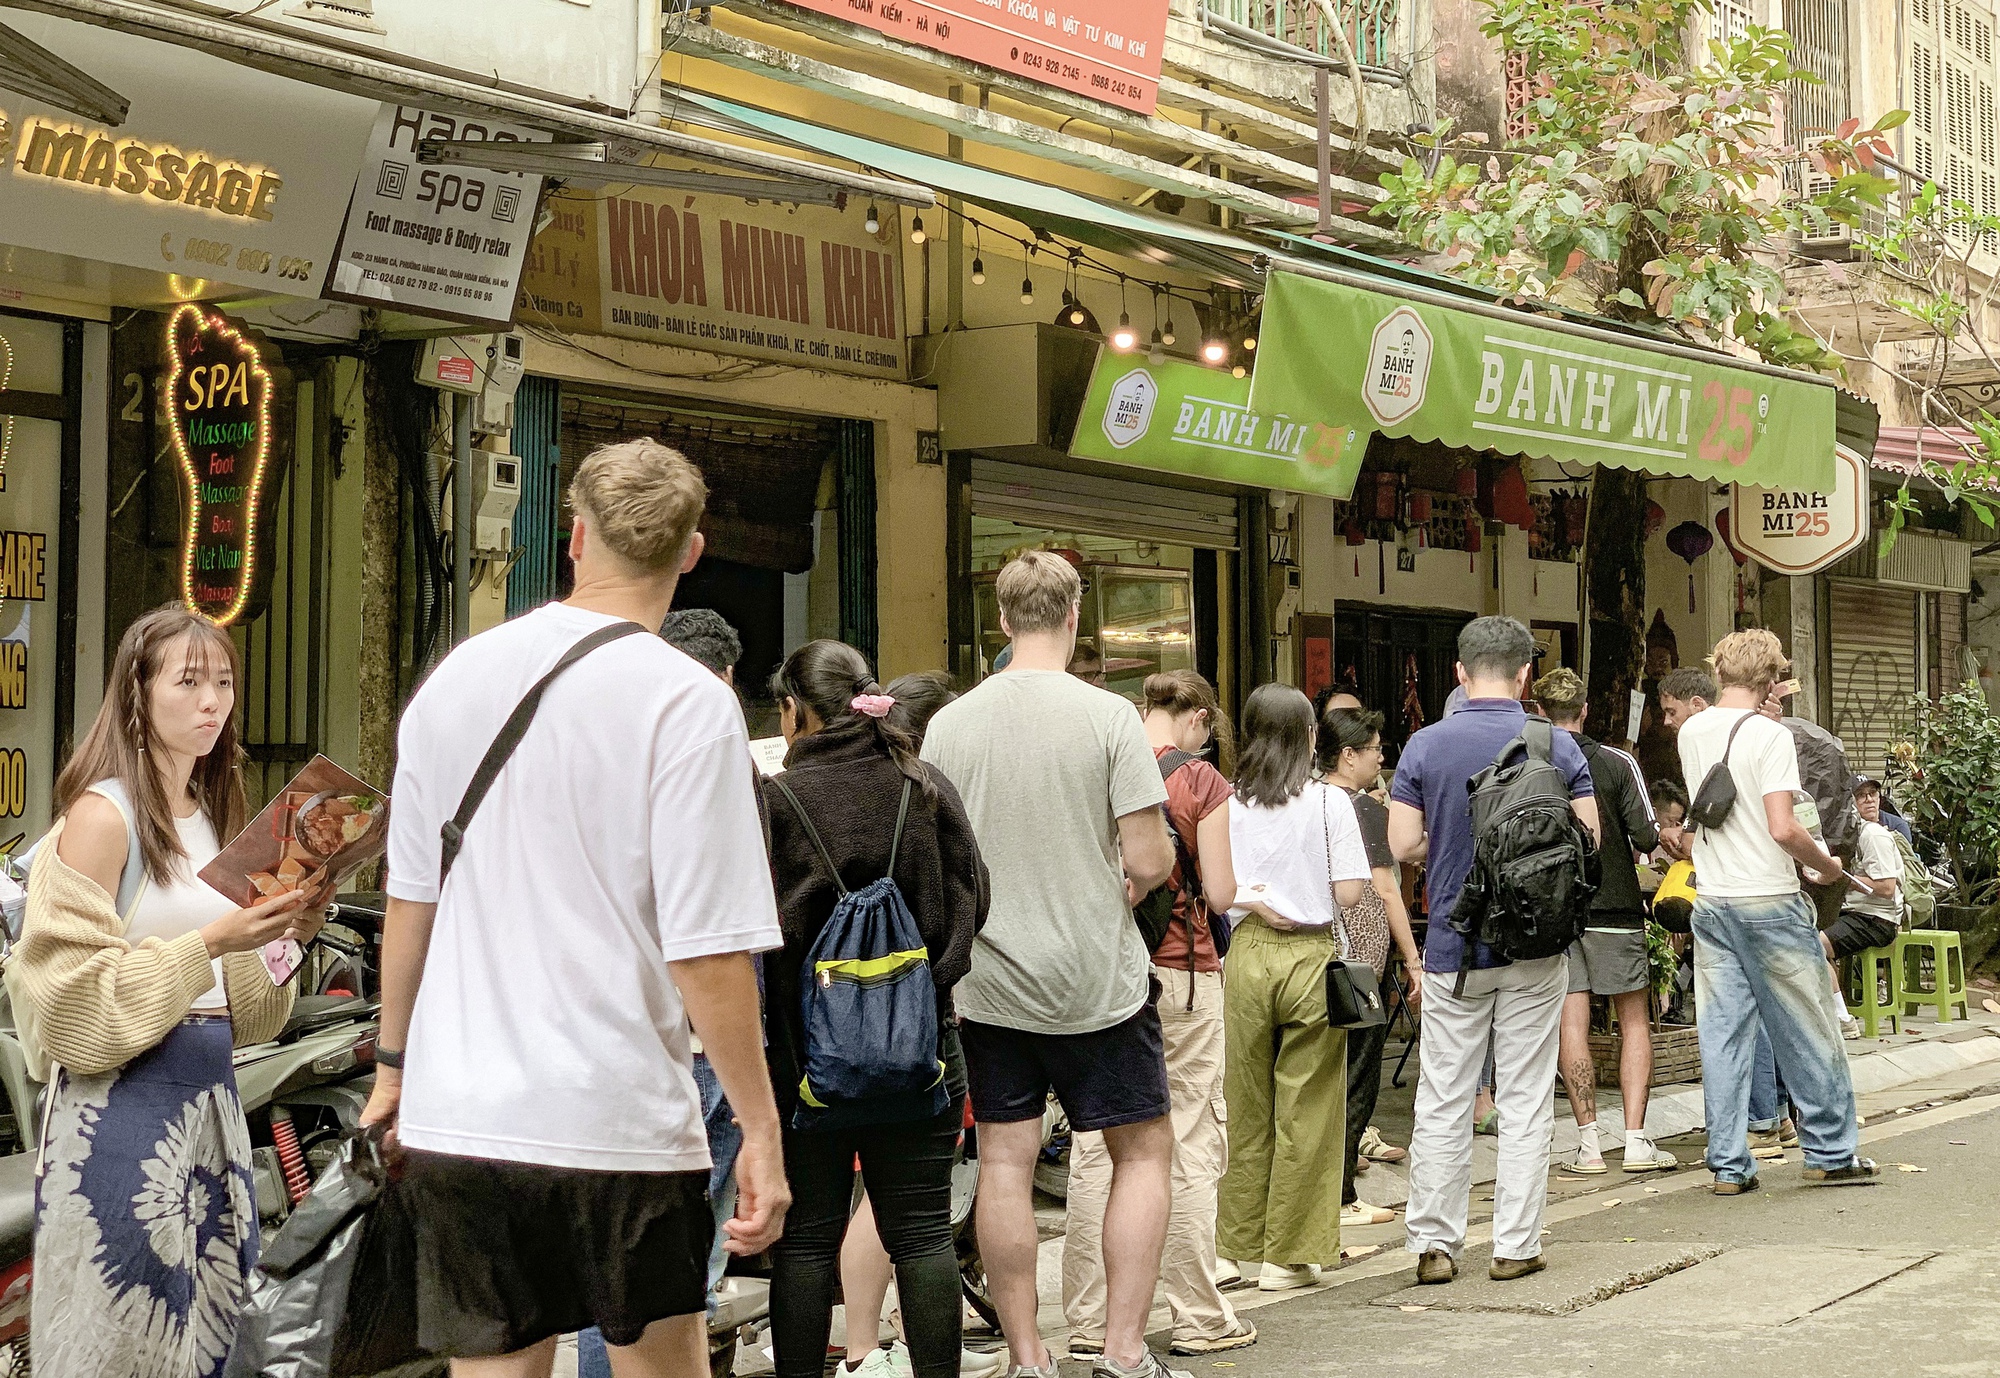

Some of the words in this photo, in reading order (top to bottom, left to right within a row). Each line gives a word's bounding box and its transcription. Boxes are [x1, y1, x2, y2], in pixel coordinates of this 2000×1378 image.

[880, 3, 902, 23] KIẾM
[916, 15, 928, 32] HÀ
[935, 21, 950, 40] NỘI
[1044, 7, 1057, 28] VÀ
[1062, 14, 1081, 37] VẬT
[1104, 30, 1124, 51] KIM
[1128, 39, 1148, 59] KHÍ
[1023, 51, 1042, 69] 0243
[1045, 58, 1060, 74] 928
[1062, 64, 1080, 81] 2145
[1091, 73, 1109, 90] 0988
[1111, 80, 1126, 96] 242
[1128, 85, 1142, 101] 854
[23, 125, 284, 222] MASSAGE
[416, 169, 486, 214] spa
[365, 211, 391, 233] Foot
[392, 216, 442, 246] massage
[444, 227, 454, 245] &
[455, 229, 482, 254] Body
[482, 237, 512, 258] relax
[551, 202, 586, 242] àng
[365, 253, 373, 262] 23
[607, 195, 707, 307] KHOÁ
[719, 218, 810, 325] MINH
[820, 240, 896, 340] KHAI
[363, 268, 378, 280] TEL:
[379, 272, 406, 285] 024.66
[406, 278, 417, 288] 82
[417, 279, 427, 290] 79
[428, 281, 438, 292] 82
[444, 284, 462, 297] 0915
[463, 286, 473, 298] 65
[473, 289, 482, 300] 88
[483, 290, 493, 302] 96
[531, 294, 564, 317] Hàng
[699, 320, 717, 339] CÁC
[719, 321, 738, 343] SẢN
[1383, 354, 1414, 374] BANH
[184, 361, 249, 411] SPA
[1118, 400, 1143, 414] BANH
[1474, 350, 1615, 434] BANH
[1632, 380, 1692, 445] MI
[1698, 380, 1754, 467] 25
[188, 418, 257, 449] Massage
[921, 437, 938, 459] 25
[1173, 402, 1260, 446] BANH
[1265, 420, 1308, 455] MI
[1305, 421, 1345, 468] 25
[209, 452, 235, 475] Foot
[1762, 490, 1828, 510] BANH
[0, 530, 46, 601] ARE
[195, 545, 216, 570] Viet
[1401, 551, 1412, 569] 27
